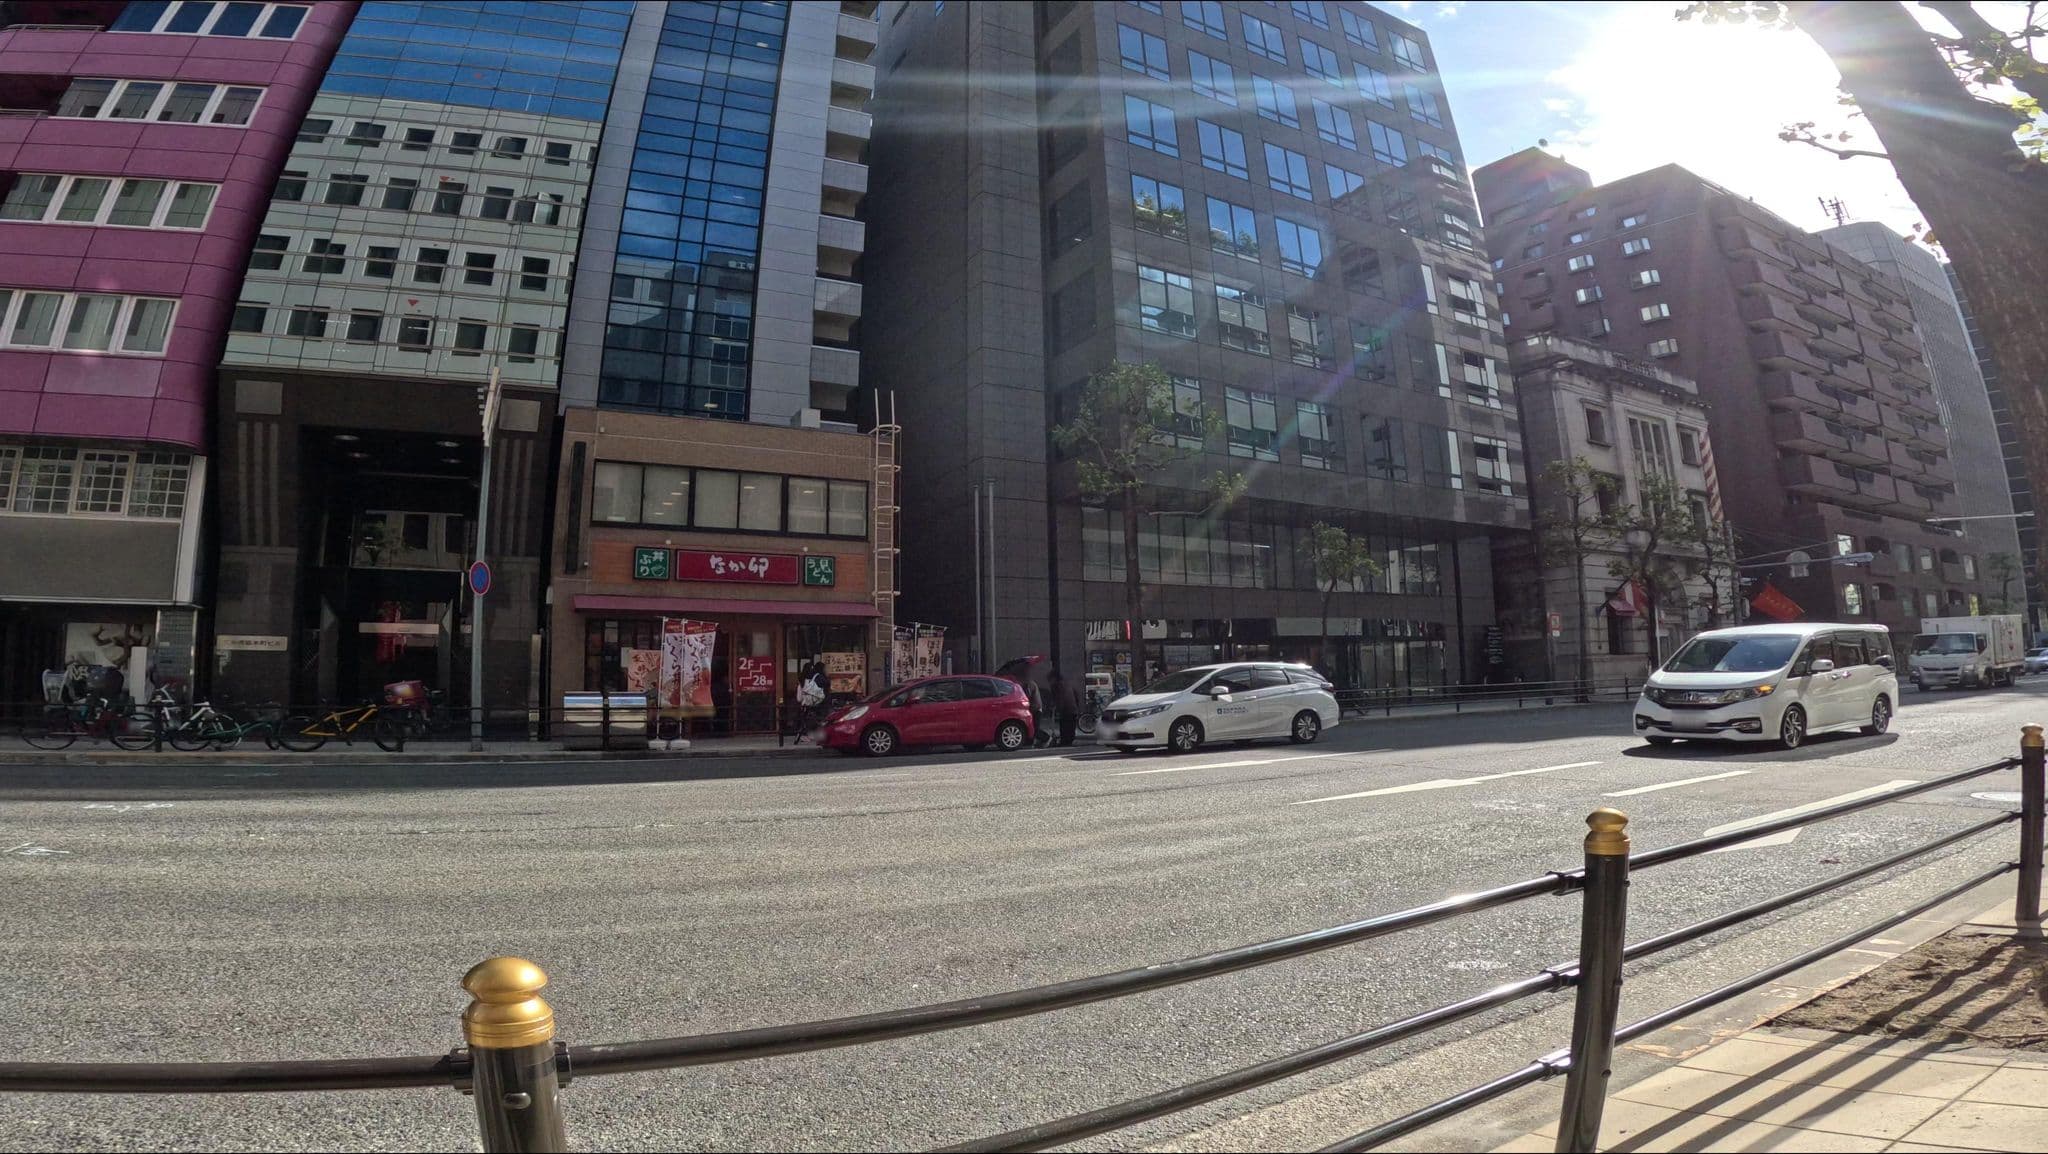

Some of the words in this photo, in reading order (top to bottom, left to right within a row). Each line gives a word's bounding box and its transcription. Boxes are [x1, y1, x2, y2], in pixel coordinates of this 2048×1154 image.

[709, 555, 769, 578] なか卯
[739, 657, 754, 670] 2F
